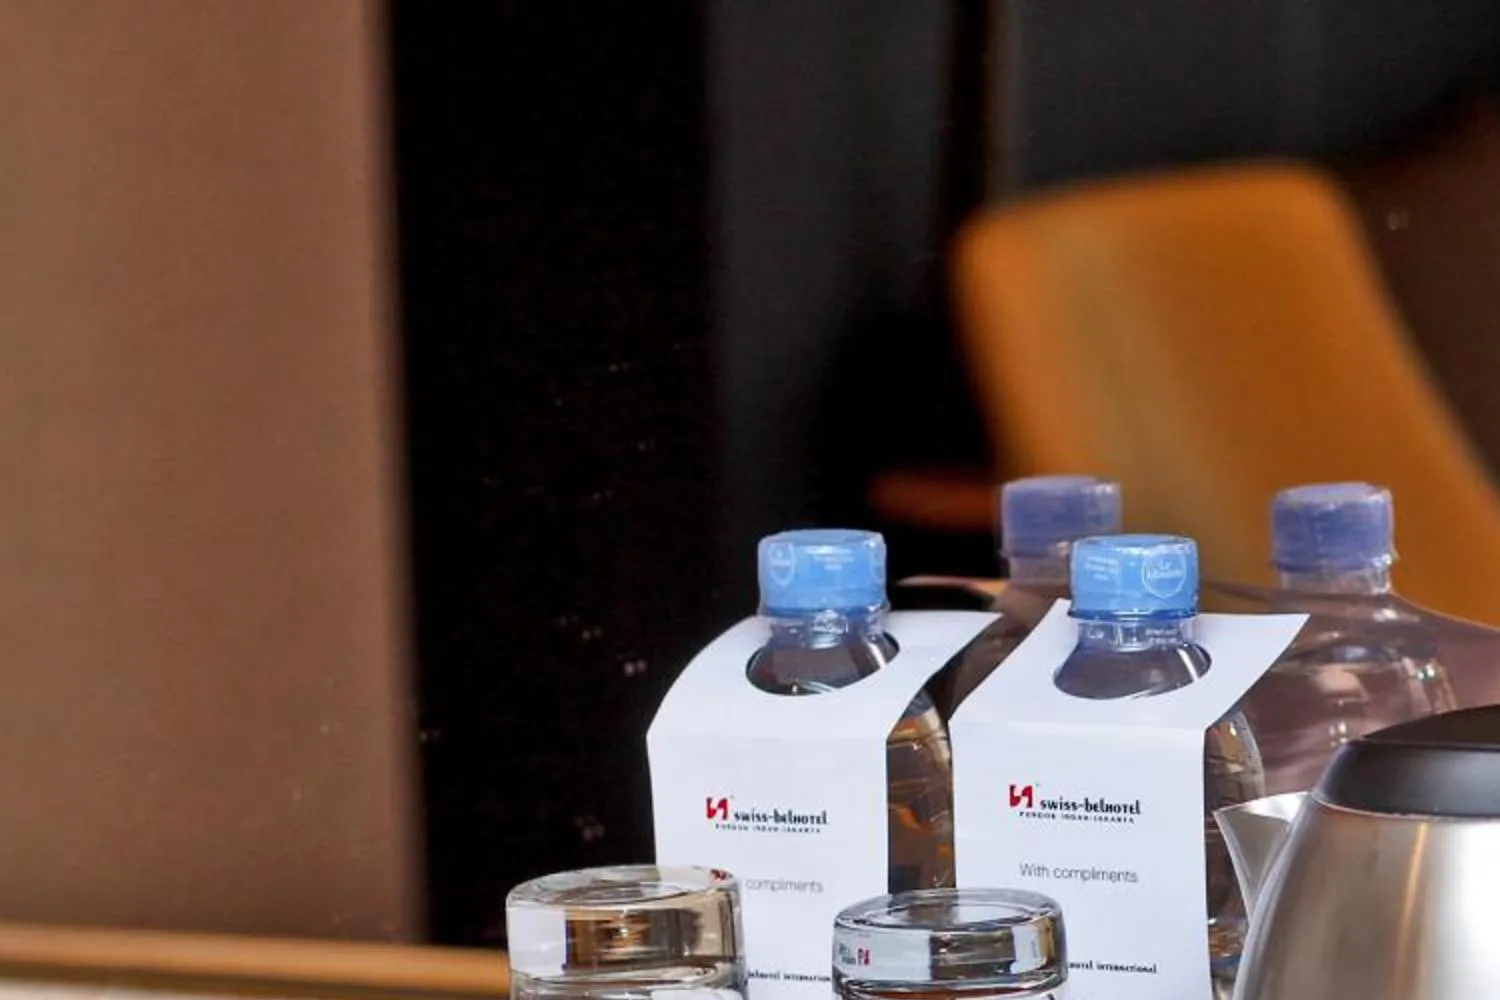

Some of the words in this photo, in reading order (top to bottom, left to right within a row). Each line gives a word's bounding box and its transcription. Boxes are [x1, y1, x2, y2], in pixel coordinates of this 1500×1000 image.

[1020, 863, 1049, 878] With
[1053, 867, 1138, 883] compliments
[746, 879, 824, 894] compliments
